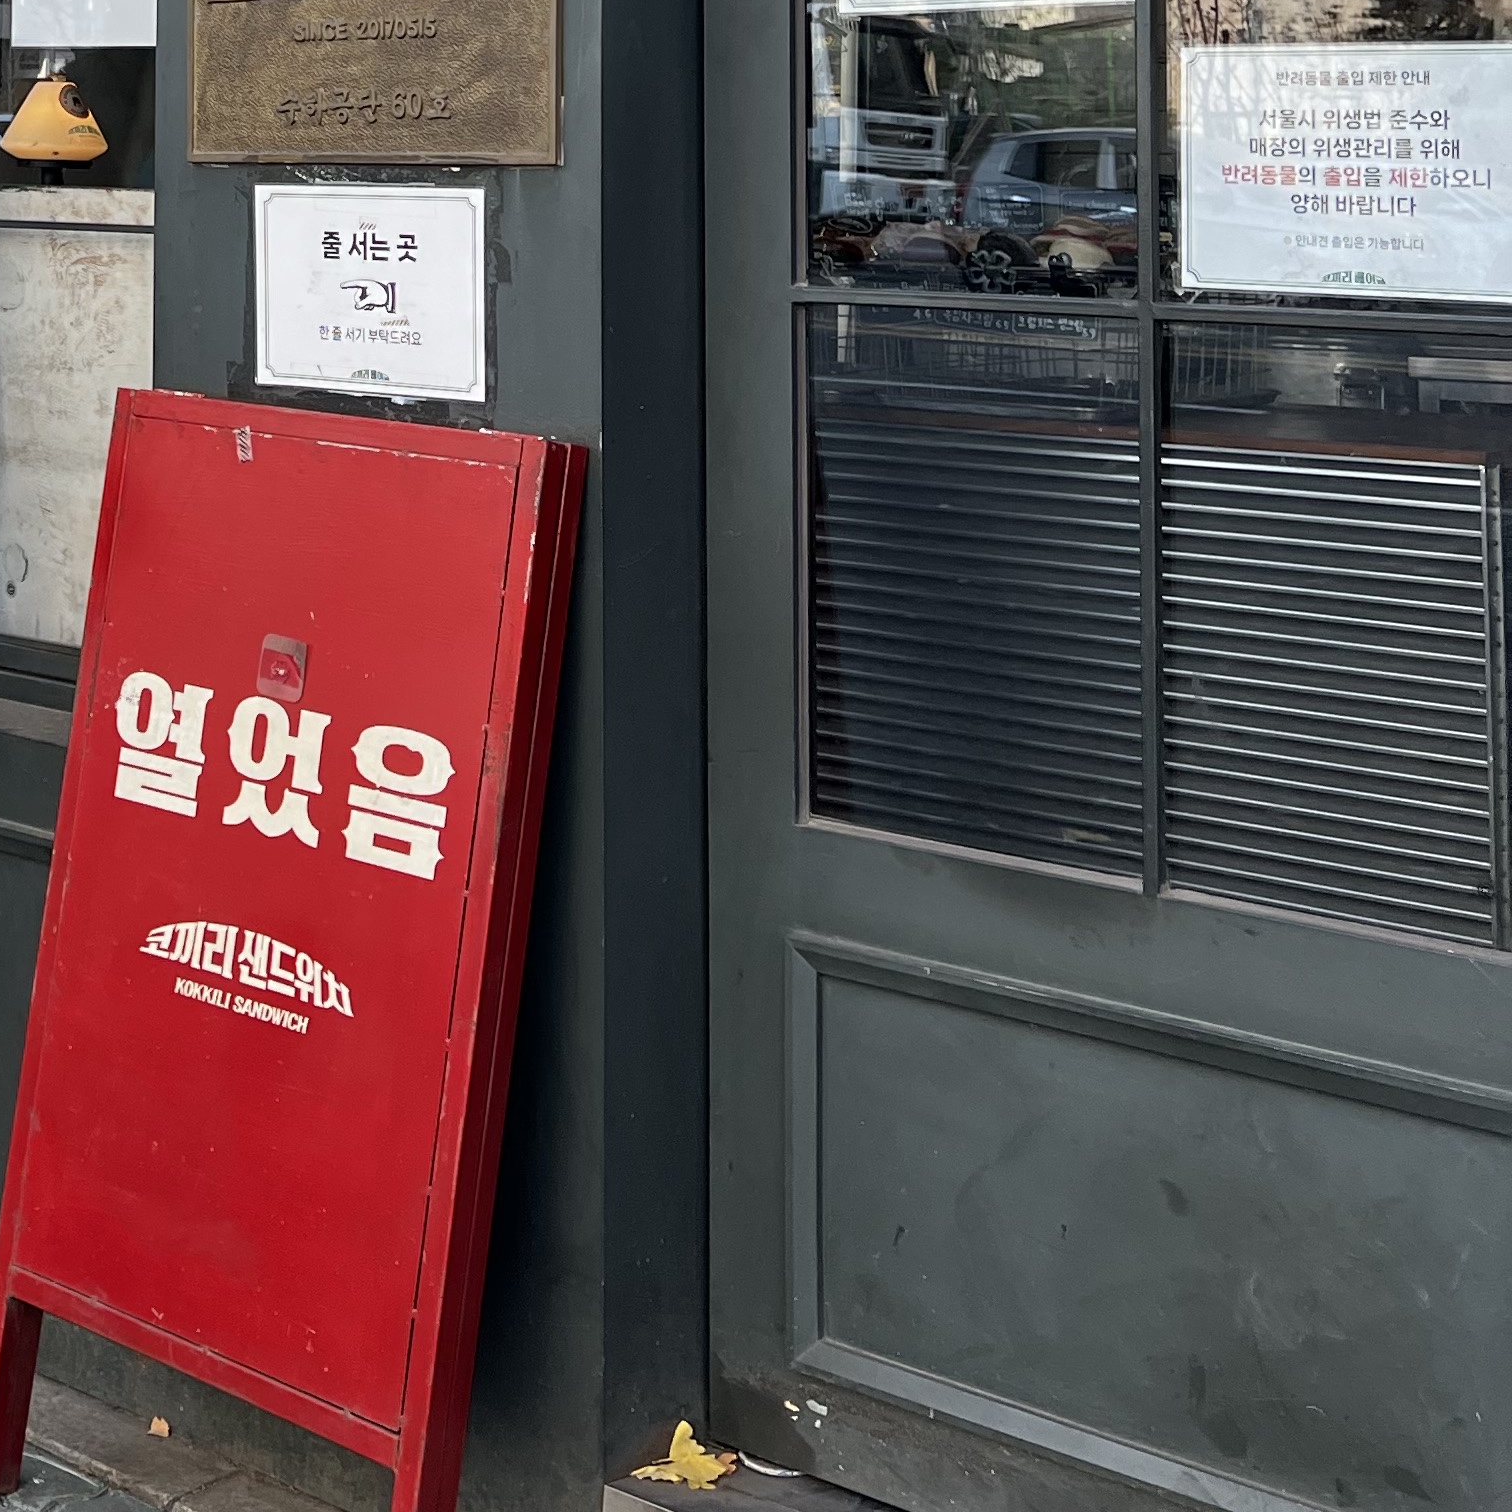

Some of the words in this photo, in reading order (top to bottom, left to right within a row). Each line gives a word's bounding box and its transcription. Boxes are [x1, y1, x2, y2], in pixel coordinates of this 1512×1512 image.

[293, 20, 349, 43] SINCE
[355, 17, 438, 41] 20170515
[1276, 70, 1332, 87] 반려동물
[1336, 70, 1364, 87] 출입
[1368, 70, 1397, 87] 제한
[1401, 70, 1431, 86] 안내
[276, 90, 383, 126] 수하공단
[391, 90, 453, 121] 60호
[1259, 108, 1316, 130] 서울시
[1322, 108, 1382, 130] 위생법
[1388, 108, 1451, 131] 준수와
[1249, 137, 1306, 159] 매장의
[1313, 137, 1414, 160] 위생관리를
[1419, 138, 1461, 160] 위해
[1221, 164, 1316, 186] 반려동물의
[1323, 165, 1382, 188] 출입을
[1388, 167, 1491, 189] 제한하오니
[1290, 194, 1329, 215] 양해
[1335, 194, 1417, 217] 바랍니다
[321, 231, 342, 259] 줄
[348, 232, 390, 261] 서는
[396, 234, 418, 262] 곳
[1295, 234, 1329, 248] 안내견
[1331, 235, 1365, 249] 출입은
[1367, 236, 1425, 251] 가능합니다
[319, 325, 330, 340] 한
[332, 326, 342, 341] 줄
[345, 327, 366, 343] 서기
[368, 328, 423, 346] 부탁드려요
[114, 670, 456, 881] 열었음
[139, 920, 240, 980] 코끼리
[237, 929, 355, 1018] 샌드위치
[173, 976, 234, 1012] KOKKILI
[232, 995, 310, 1035] SANDWICH
